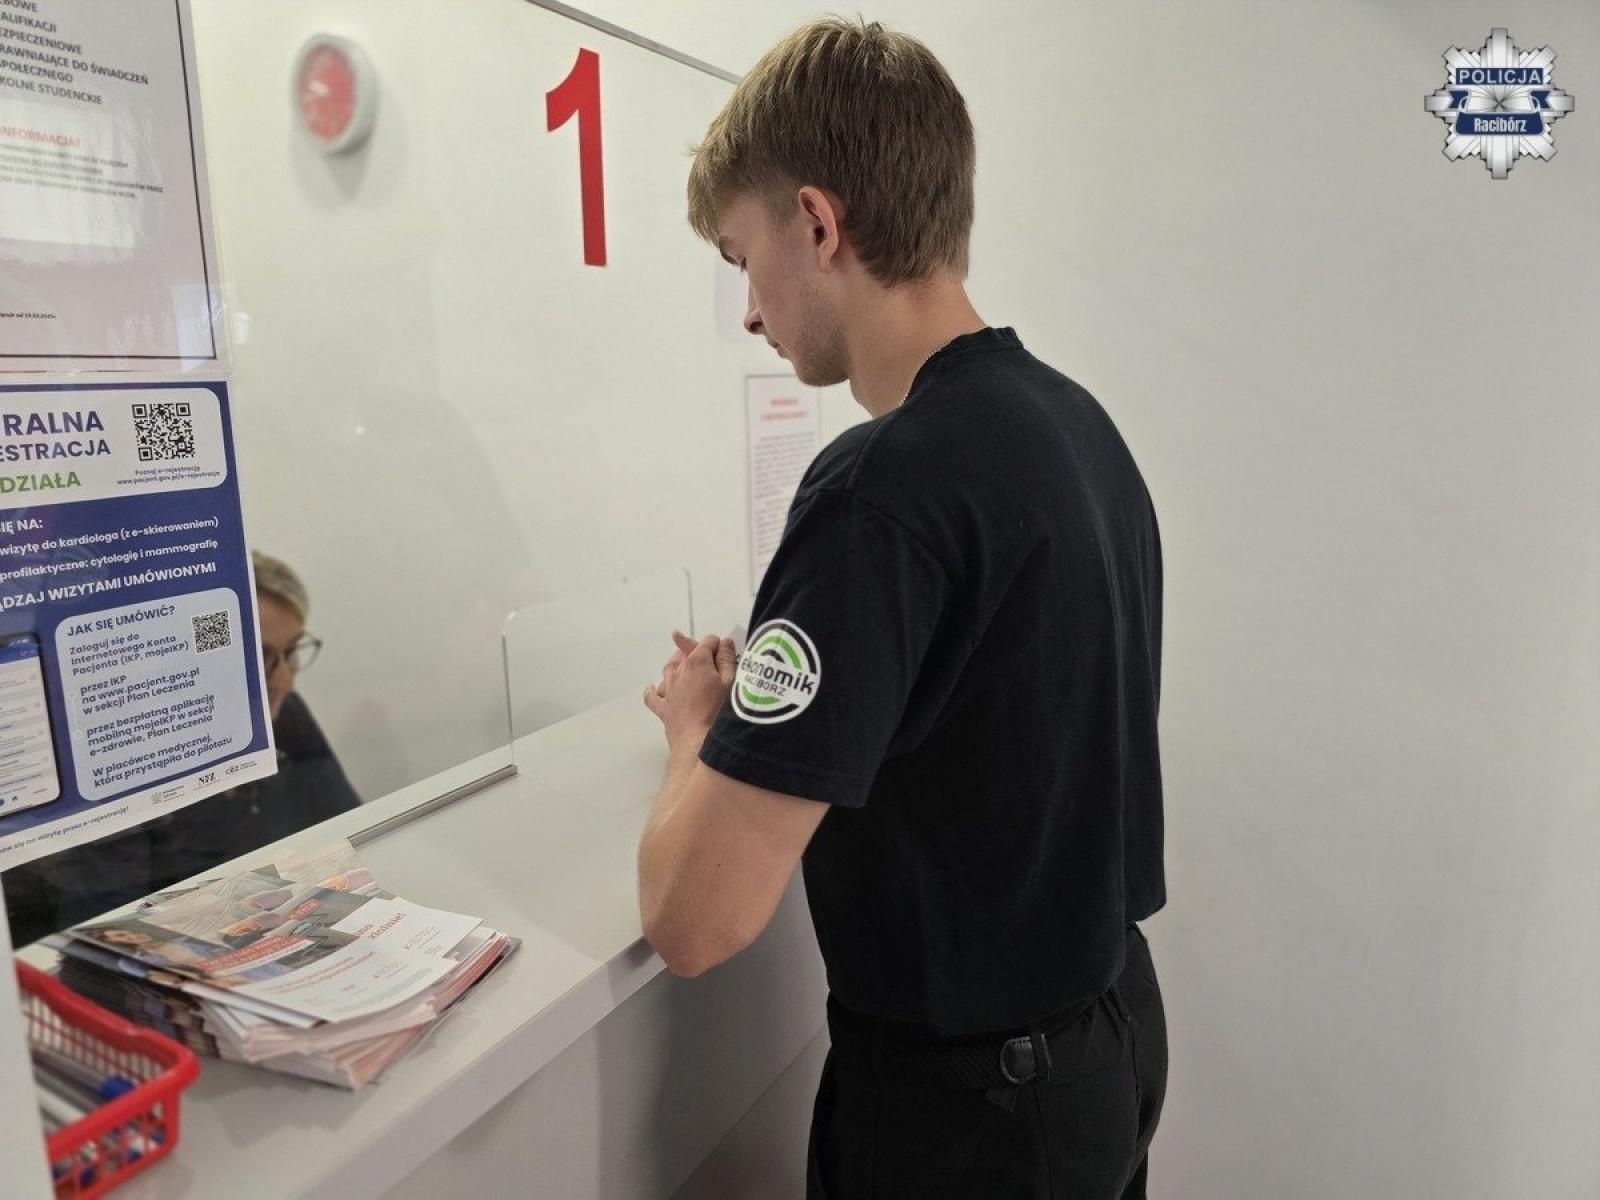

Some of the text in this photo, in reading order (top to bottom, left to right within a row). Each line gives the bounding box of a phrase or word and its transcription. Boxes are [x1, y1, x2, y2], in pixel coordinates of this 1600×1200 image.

[72, 60, 88, 72] DO
[90, 62, 149, 86] ŚWIADCZEŃ
[37, 82, 103, 104] STUDENCKIE
[545, 47, 607, 267] 1
[2, 411, 105, 437] RALNA
[0, 471, 81, 494] DZIAŁA
[17, 518, 44, 531] NA:
[0, 543, 40, 556] wizytę
[41, 540, 57, 550] do
[59, 531, 119, 548] kardiologa
[0, 560, 88, 583] profilaktyczne:
[90, 551, 139, 569] cytologię
[145, 539, 218, 557] mammografię
[48, 577, 121, 600] WIZYTAMI
[124, 562, 217, 586] UMÓWIONYMI
[68, 605, 176, 637] JAK SIĘ UMÓWIĆ?
[69, 633, 139, 654] Zaloguj się do
[71, 635, 176, 664] Internetowego Konta
[72, 658, 118, 676] Pacjenta
[145, 642, 189, 658] mojeIKP)
[80, 675, 127, 696] przez IKP
[81, 667, 200, 705] na www.pacjent.gov.pl
[741, 657, 815, 695] ekonomik
[83, 679, 195, 715] w sekcji Plan Leczenia
[86, 694, 215, 738] przez bezpłatną aplikację
[87, 703, 215, 746] mobilną mojeIKP w sekcji
[90, 714, 213, 756] e-zdrowie, Plan Leczenia
[92, 767, 104, 777] W
[105, 751, 157, 774] placówce
[93, 736, 233, 787] która przystąpiła do pilotażu
